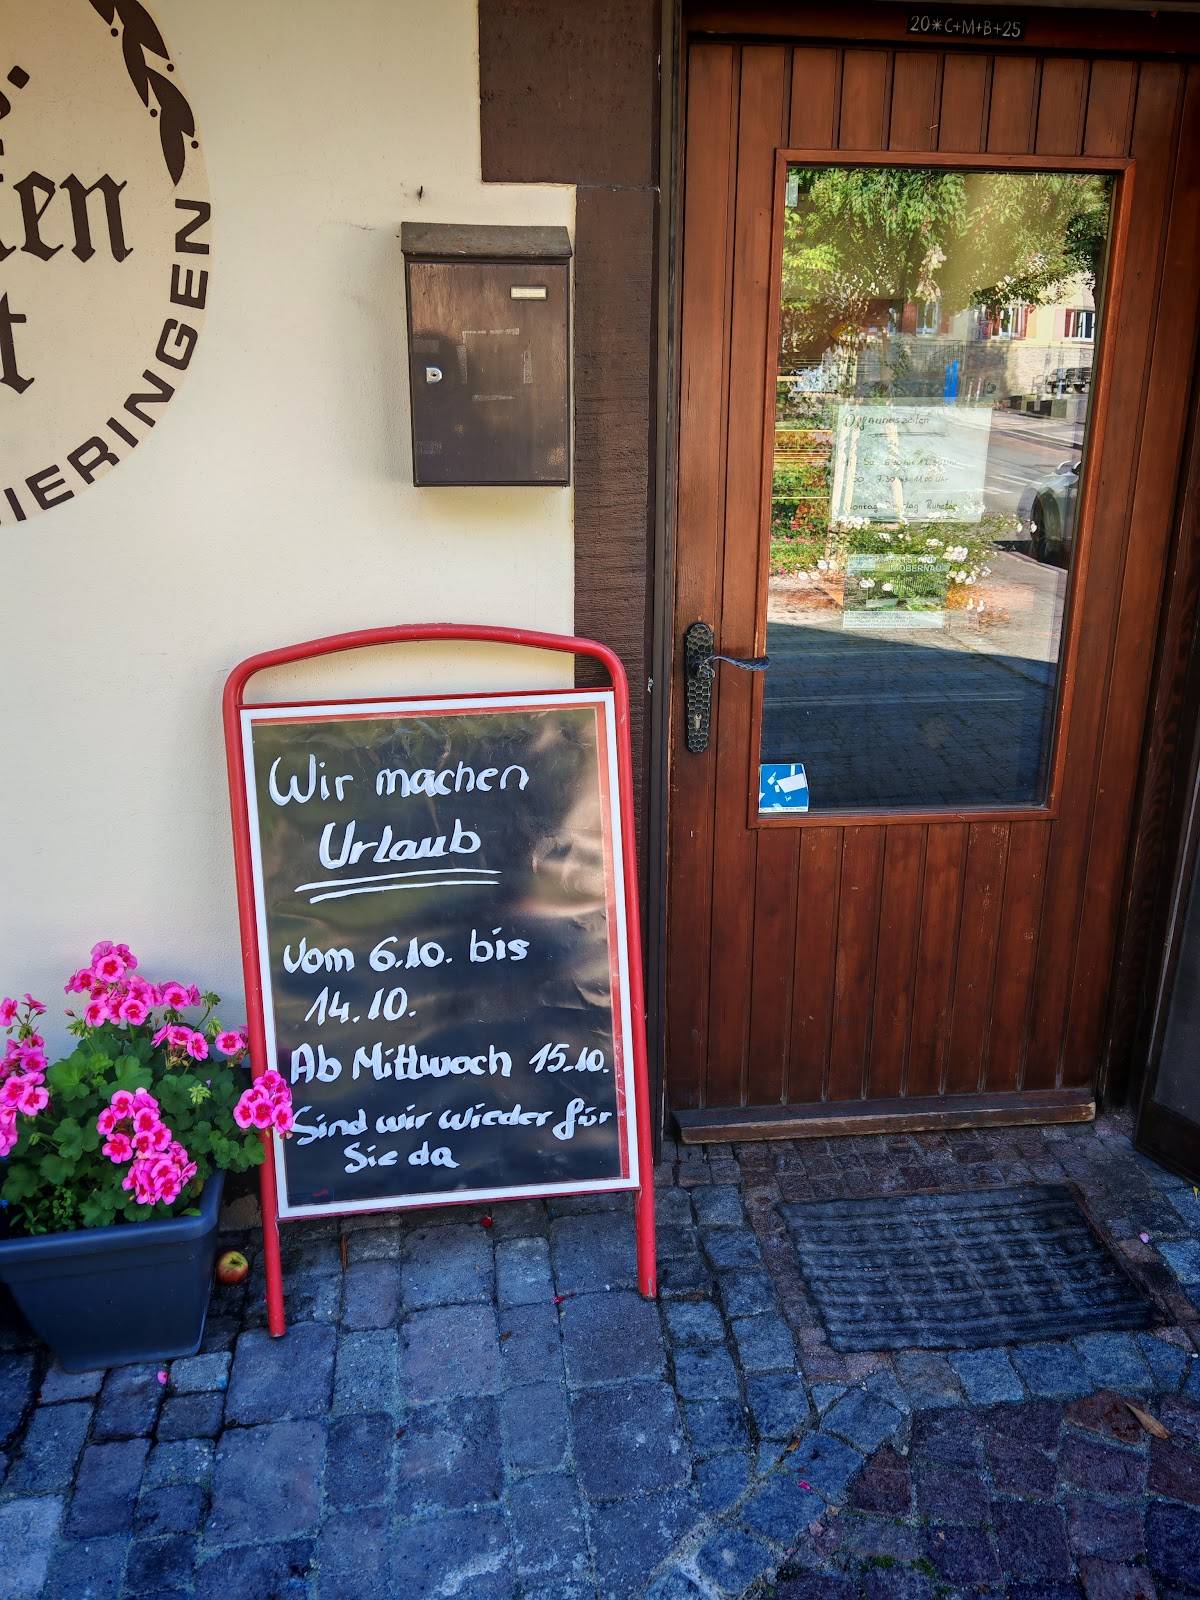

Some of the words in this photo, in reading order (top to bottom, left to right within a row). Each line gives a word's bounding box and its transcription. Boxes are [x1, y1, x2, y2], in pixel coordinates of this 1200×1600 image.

[268, 754, 354, 806] Wir
[374, 760, 531, 799] machen
[318, 819, 483, 869] Urlaub
[368, 935, 454, 971] 6.10.
[469, 925, 531, 963] bis
[303, 985, 418, 1027] 14.10.
[290, 1042, 343, 1084] Ab
[351, 1040, 513, 1081] Mittwoch
[527, 1041, 611, 1074] 15.10.
[287, 1105, 369, 1146] Sind
[374, 1103, 433, 1135] wir
[437, 1102, 554, 1132] wieder
[551, 1097, 614, 1142] für
[342, 1141, 399, 1174] Sie
[406, 1140, 462, 1169] da
